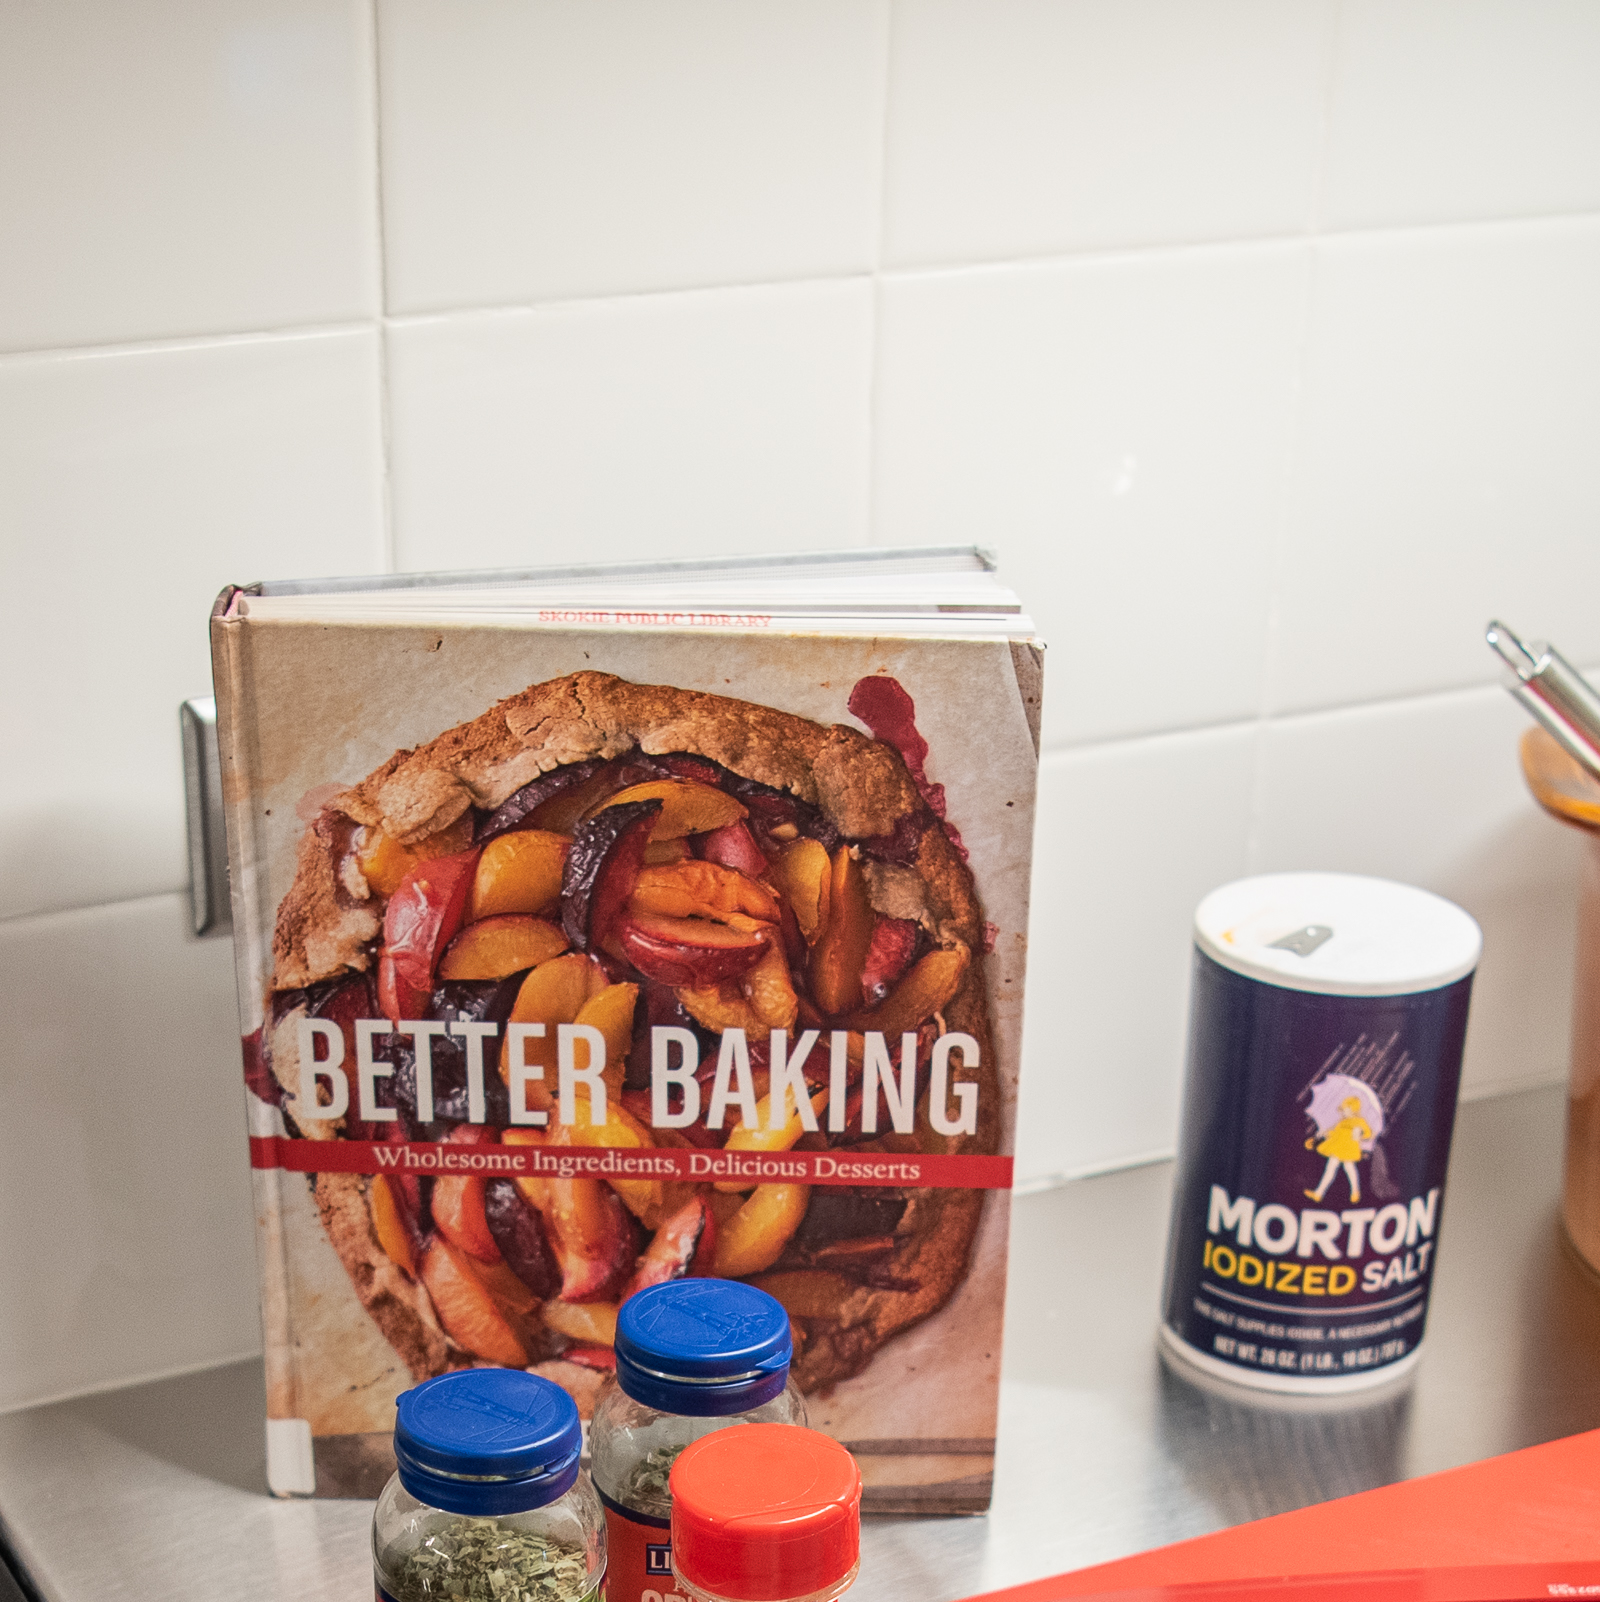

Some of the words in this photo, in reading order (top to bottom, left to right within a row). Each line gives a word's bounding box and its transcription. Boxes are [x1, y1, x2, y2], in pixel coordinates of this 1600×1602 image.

[538, 610, 609, 624] SKOKIE
[615, 611, 684, 626] PUBLIC
[690, 613, 772, 628] LIBRARY
[298, 1017, 608, 1127] BETTER
[651, 1025, 981, 1136] BAKING
[373, 1146, 526, 1171] Wholesome
[533, 1150, 682, 1177] Ingredients,
[689, 1153, 808, 1178] Delicious
[814, 1157, 921, 1181] Desserts
[1207, 1183, 1440, 1261] MORTON
[1203, 1239, 1357, 1297] IODIZED
[1361, 1241, 1432, 1294] SALT
